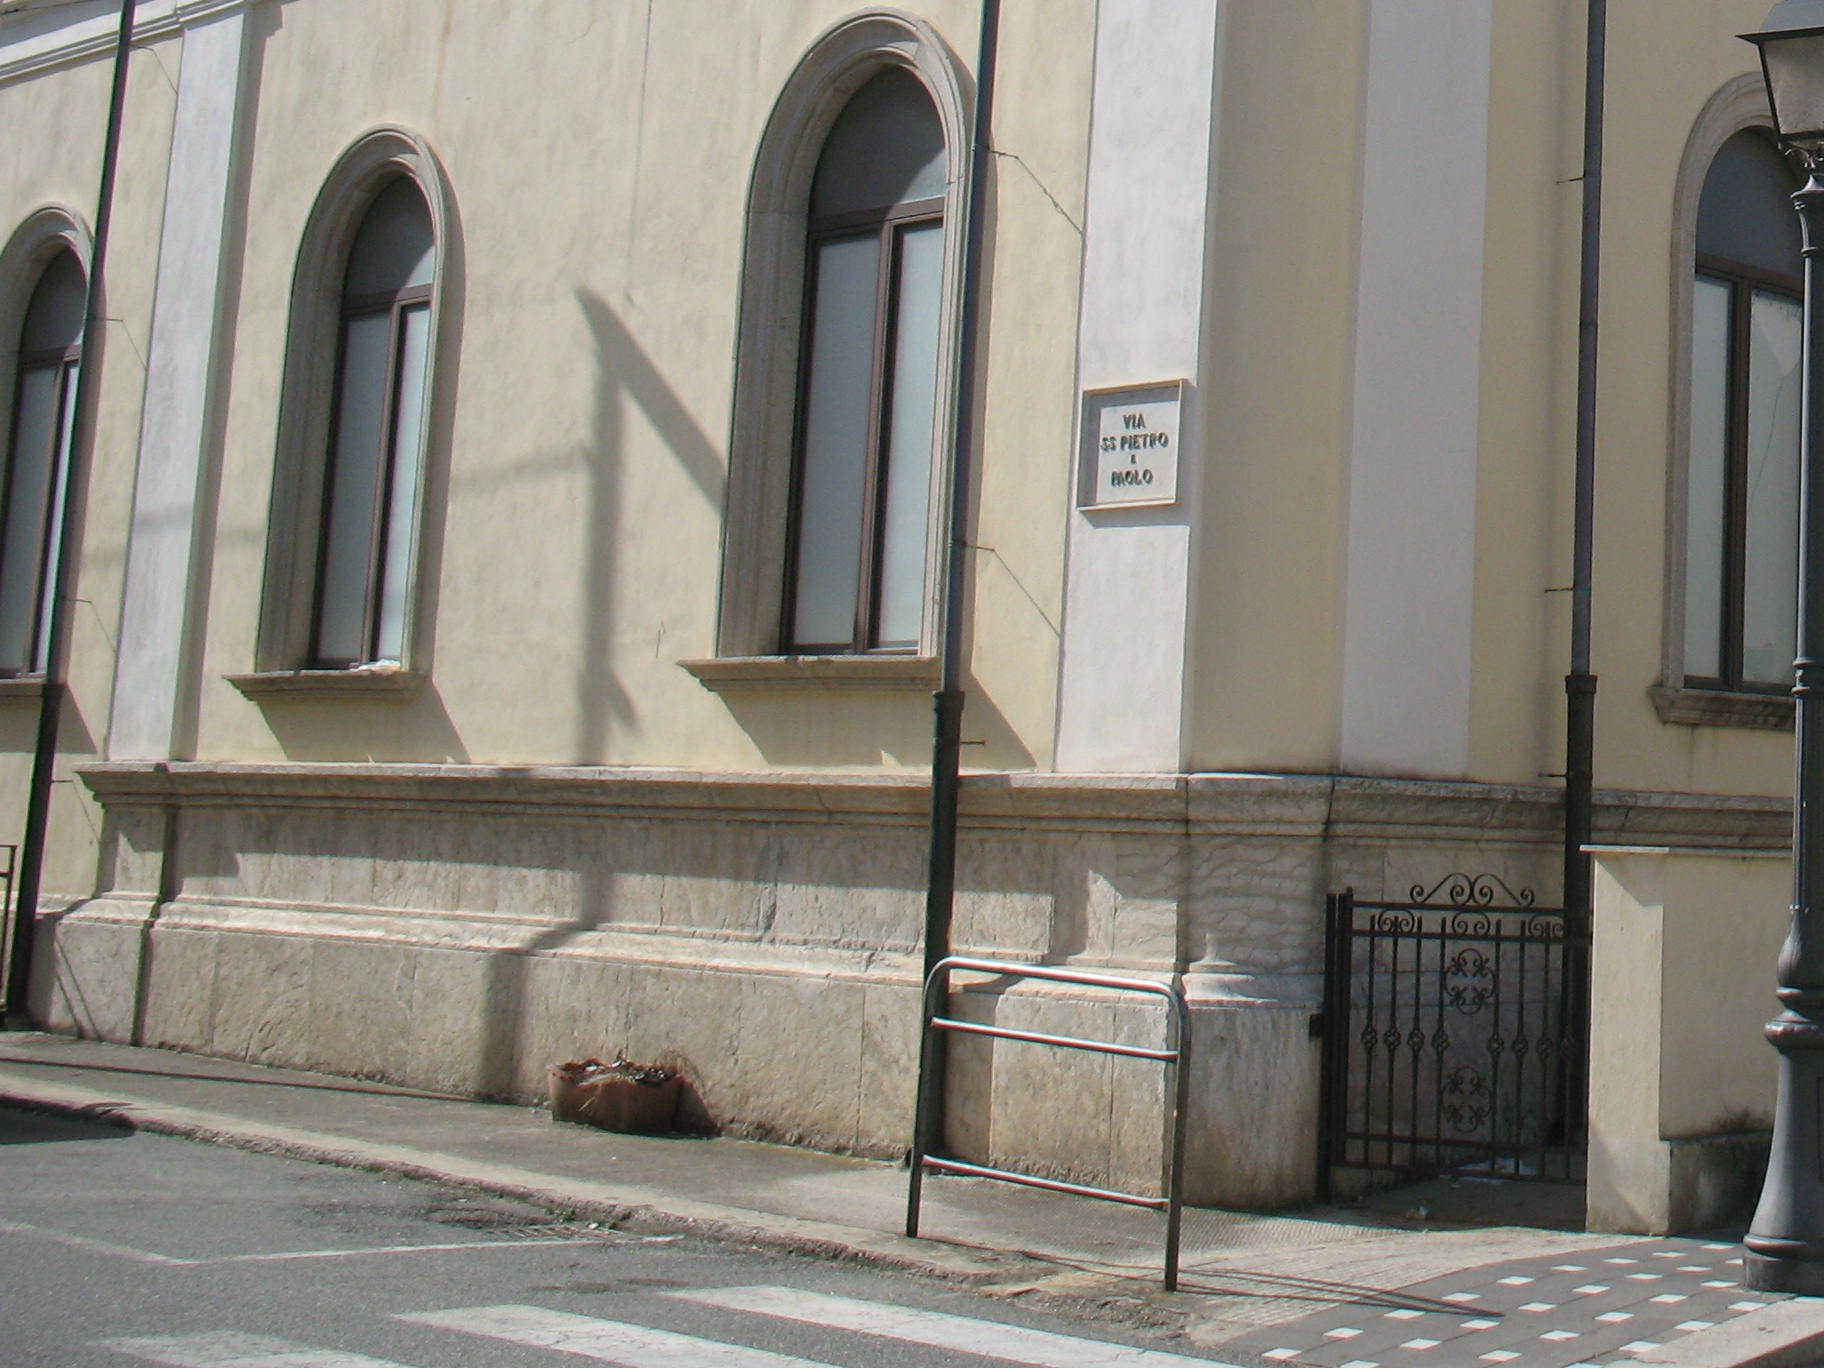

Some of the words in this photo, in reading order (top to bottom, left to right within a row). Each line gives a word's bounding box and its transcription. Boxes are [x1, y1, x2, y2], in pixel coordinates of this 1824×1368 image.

[1123, 413, 1146, 429] VIA
[1120, 432, 1169, 451] PIETRO
[1111, 469, 1153, 487] PAOLO
